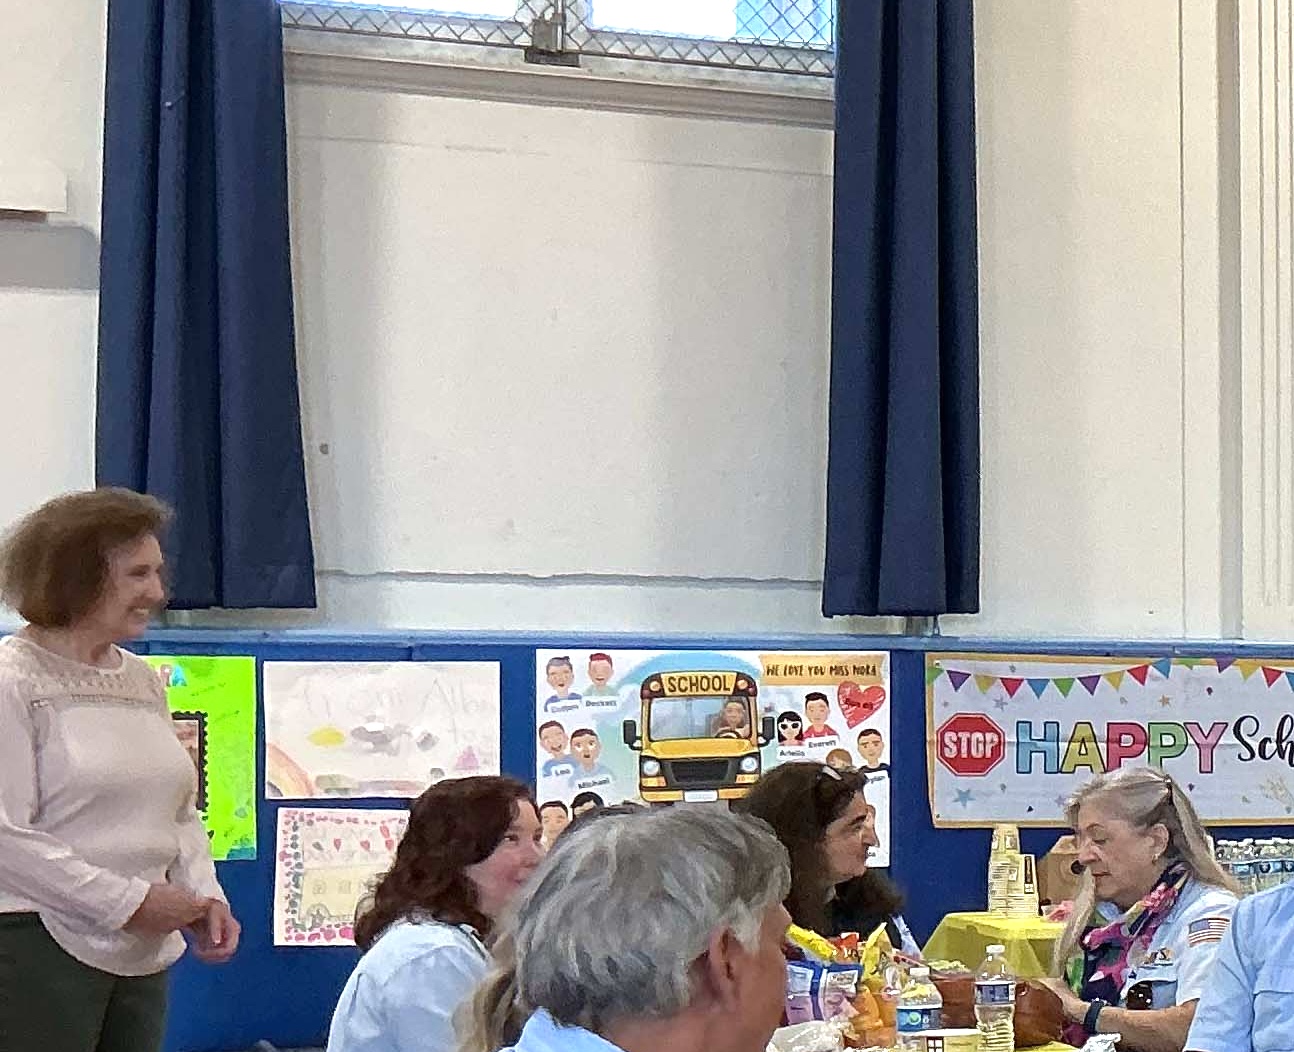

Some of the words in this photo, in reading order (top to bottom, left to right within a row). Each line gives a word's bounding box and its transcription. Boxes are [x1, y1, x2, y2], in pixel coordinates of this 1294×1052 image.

[766, 663, 779, 677] WE
[783, 663, 804, 677] LOVE
[807, 663, 825, 676] YOU
[829, 662, 850, 676] MISS
[666, 674, 731, 694] SCHOOL
[943, 730, 999, 760] STOP
[1016, 721, 1229, 774] HAPPY
